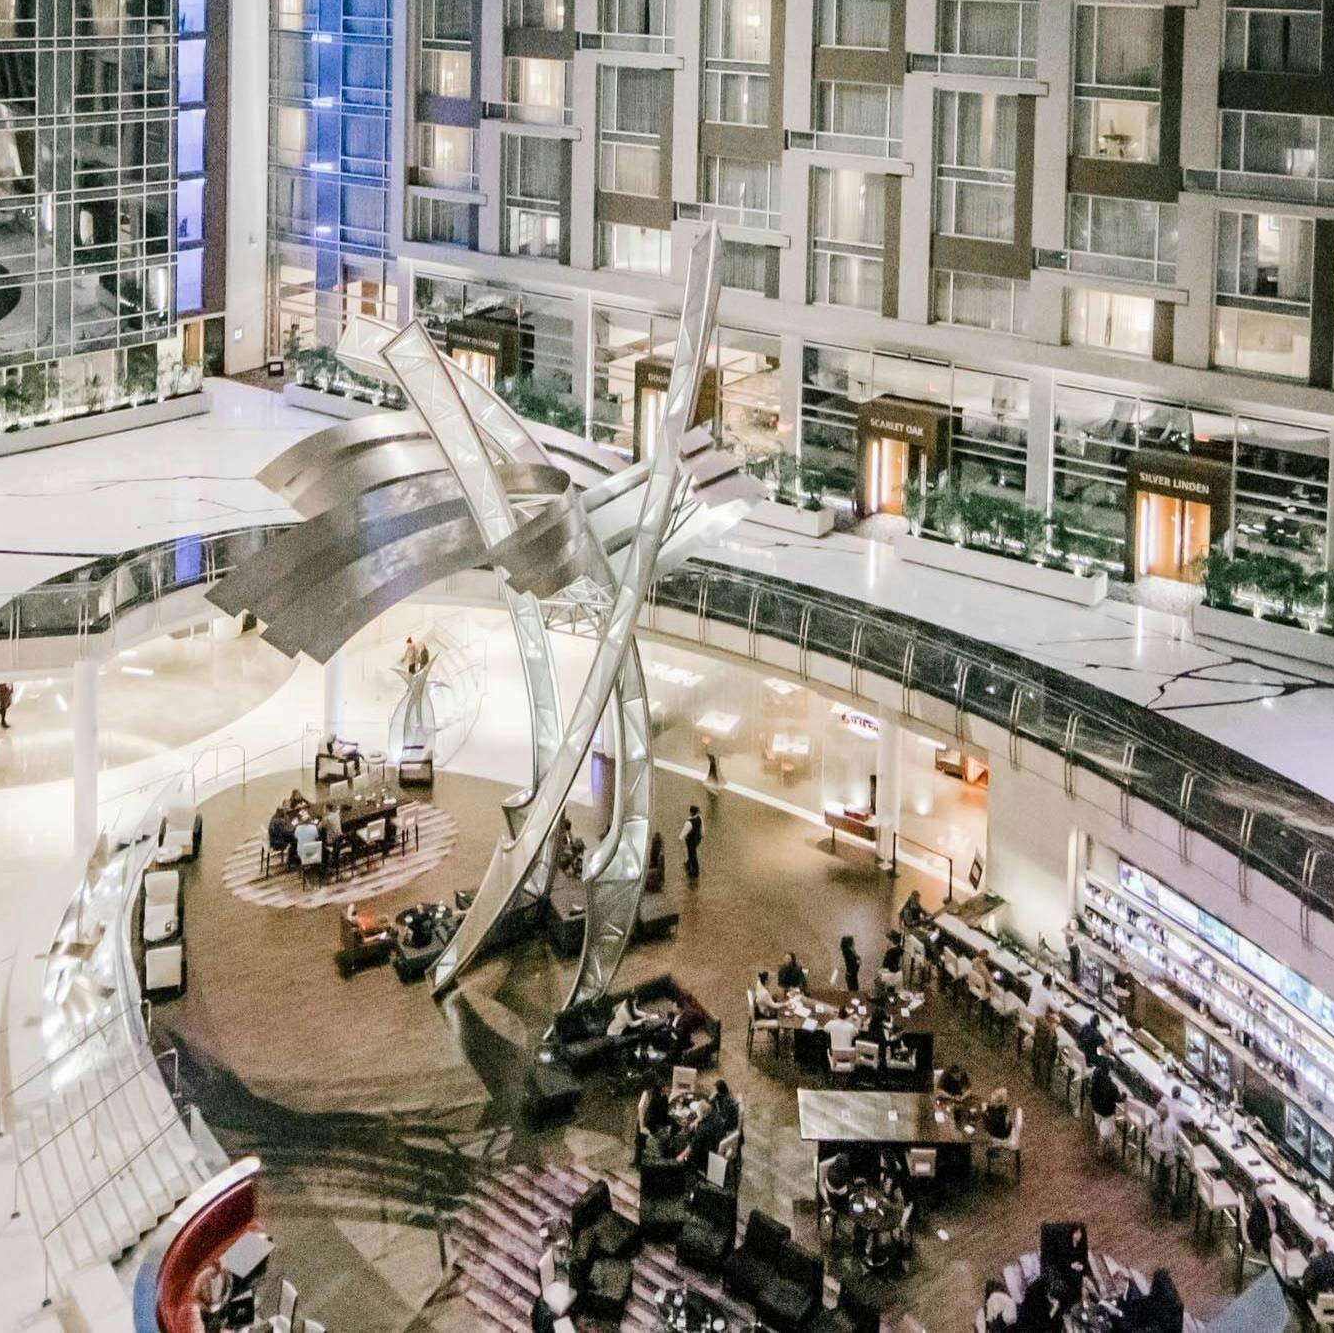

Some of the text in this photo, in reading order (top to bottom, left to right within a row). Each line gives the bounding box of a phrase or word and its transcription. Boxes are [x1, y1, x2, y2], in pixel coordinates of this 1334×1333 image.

[870, 417, 924, 436] SCARLET OAK
[1139, 471, 1210, 495] SILVER LINDEN
